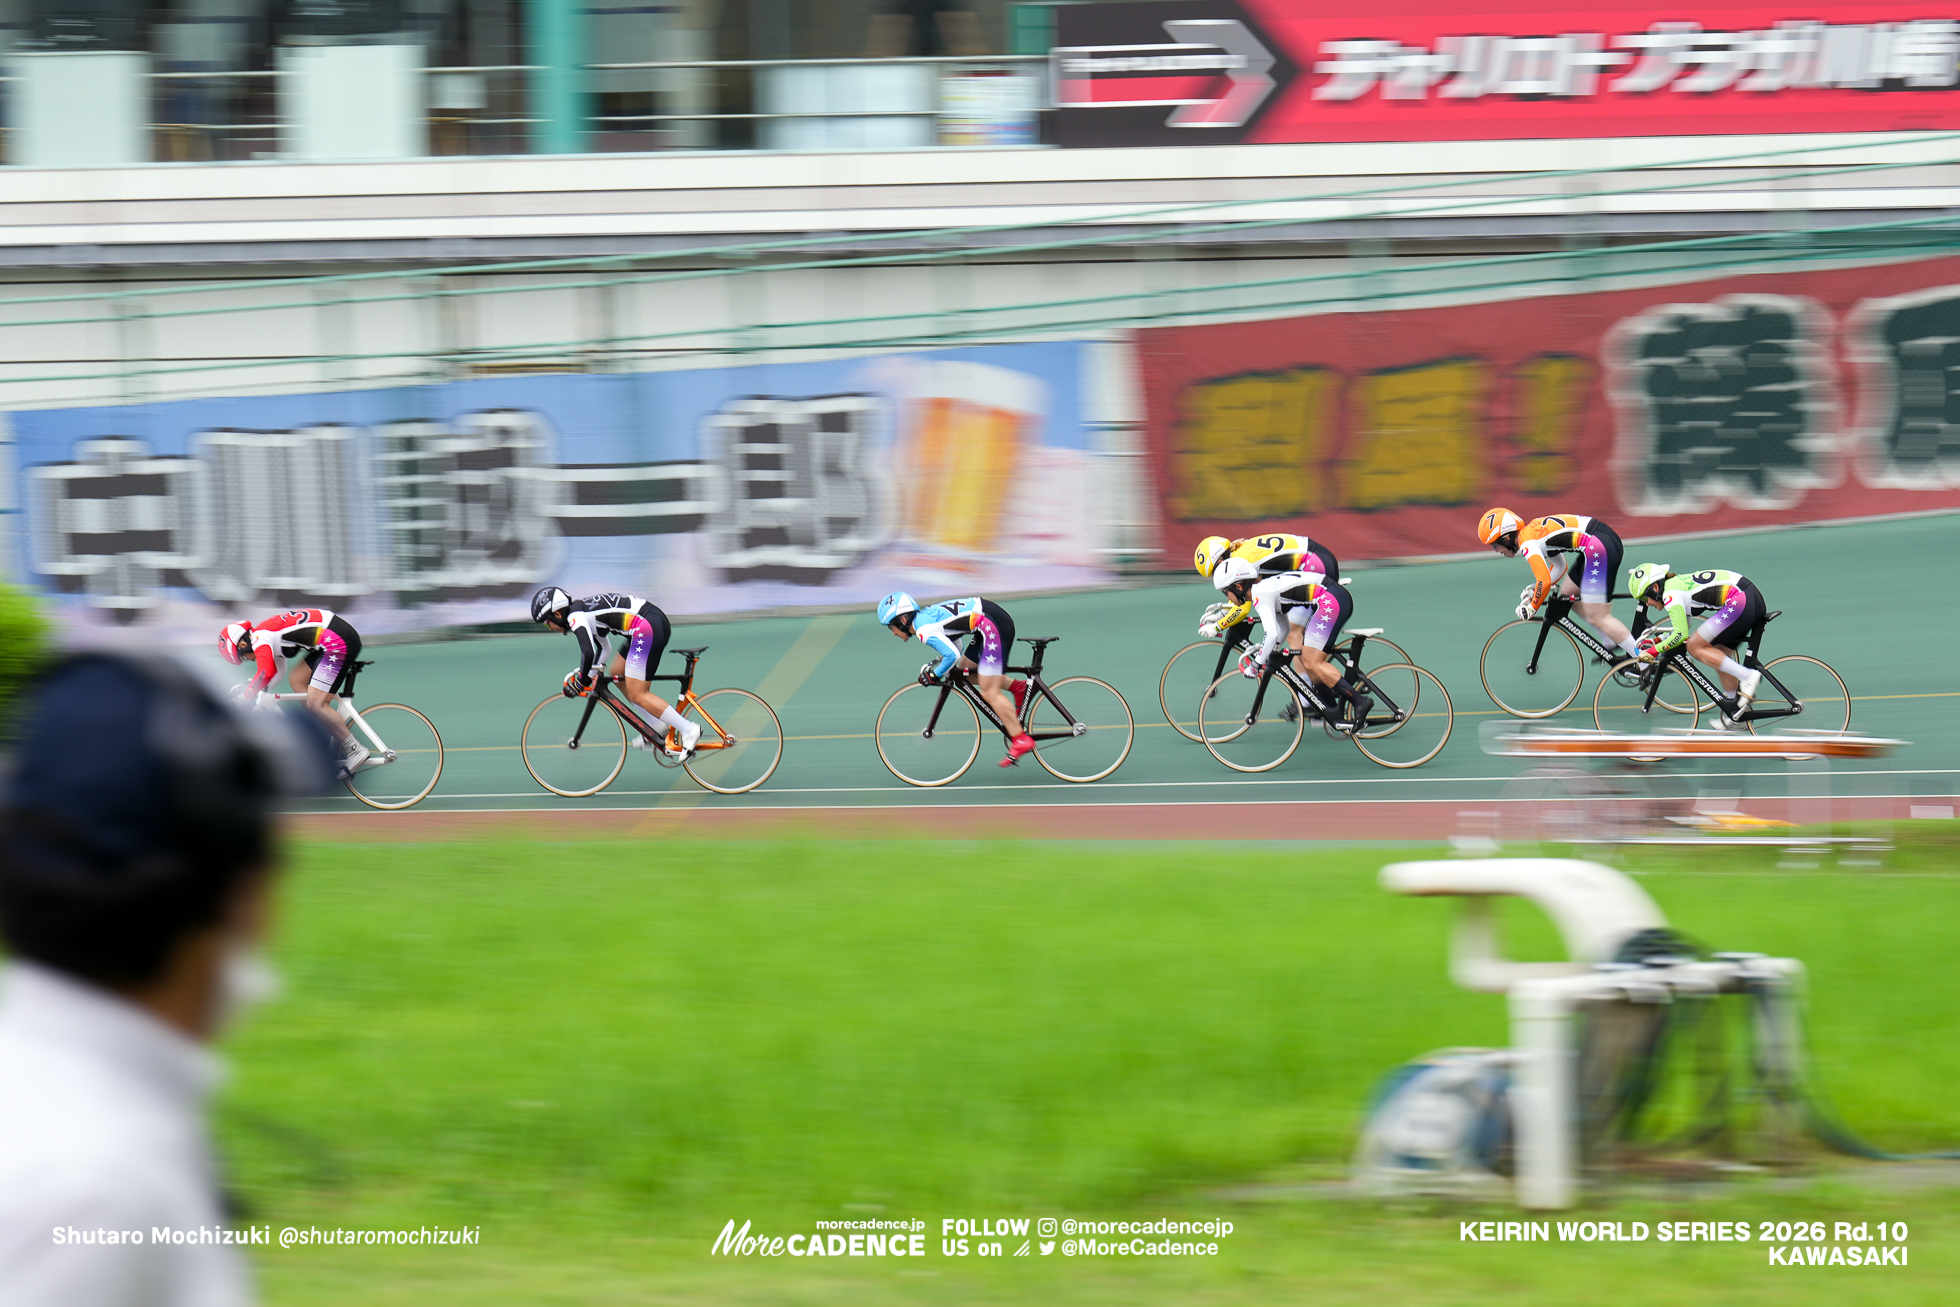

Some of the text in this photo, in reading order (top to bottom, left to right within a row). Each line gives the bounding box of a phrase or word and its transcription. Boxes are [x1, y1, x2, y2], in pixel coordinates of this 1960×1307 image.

[1486, 513, 1496, 530] 7
[1257, 535, 1285, 553] 5
[1196, 549, 1206, 565] 5
[1224, 561, 1229, 574] 1
[1634, 569, 1645, 579] 6
[1692, 571, 1716, 585] 6
[1535, 580, 1544, 600] KEIRIN
[940, 600, 965, 616] 4
[1226, 607, 1242, 623] KEIRIN
[1558, 616, 1614, 662] BRIDGESTONE
[1673, 653, 1724, 702] BRIDGESTONE
[1280, 664, 1327, 711] BRIDGESTONE
